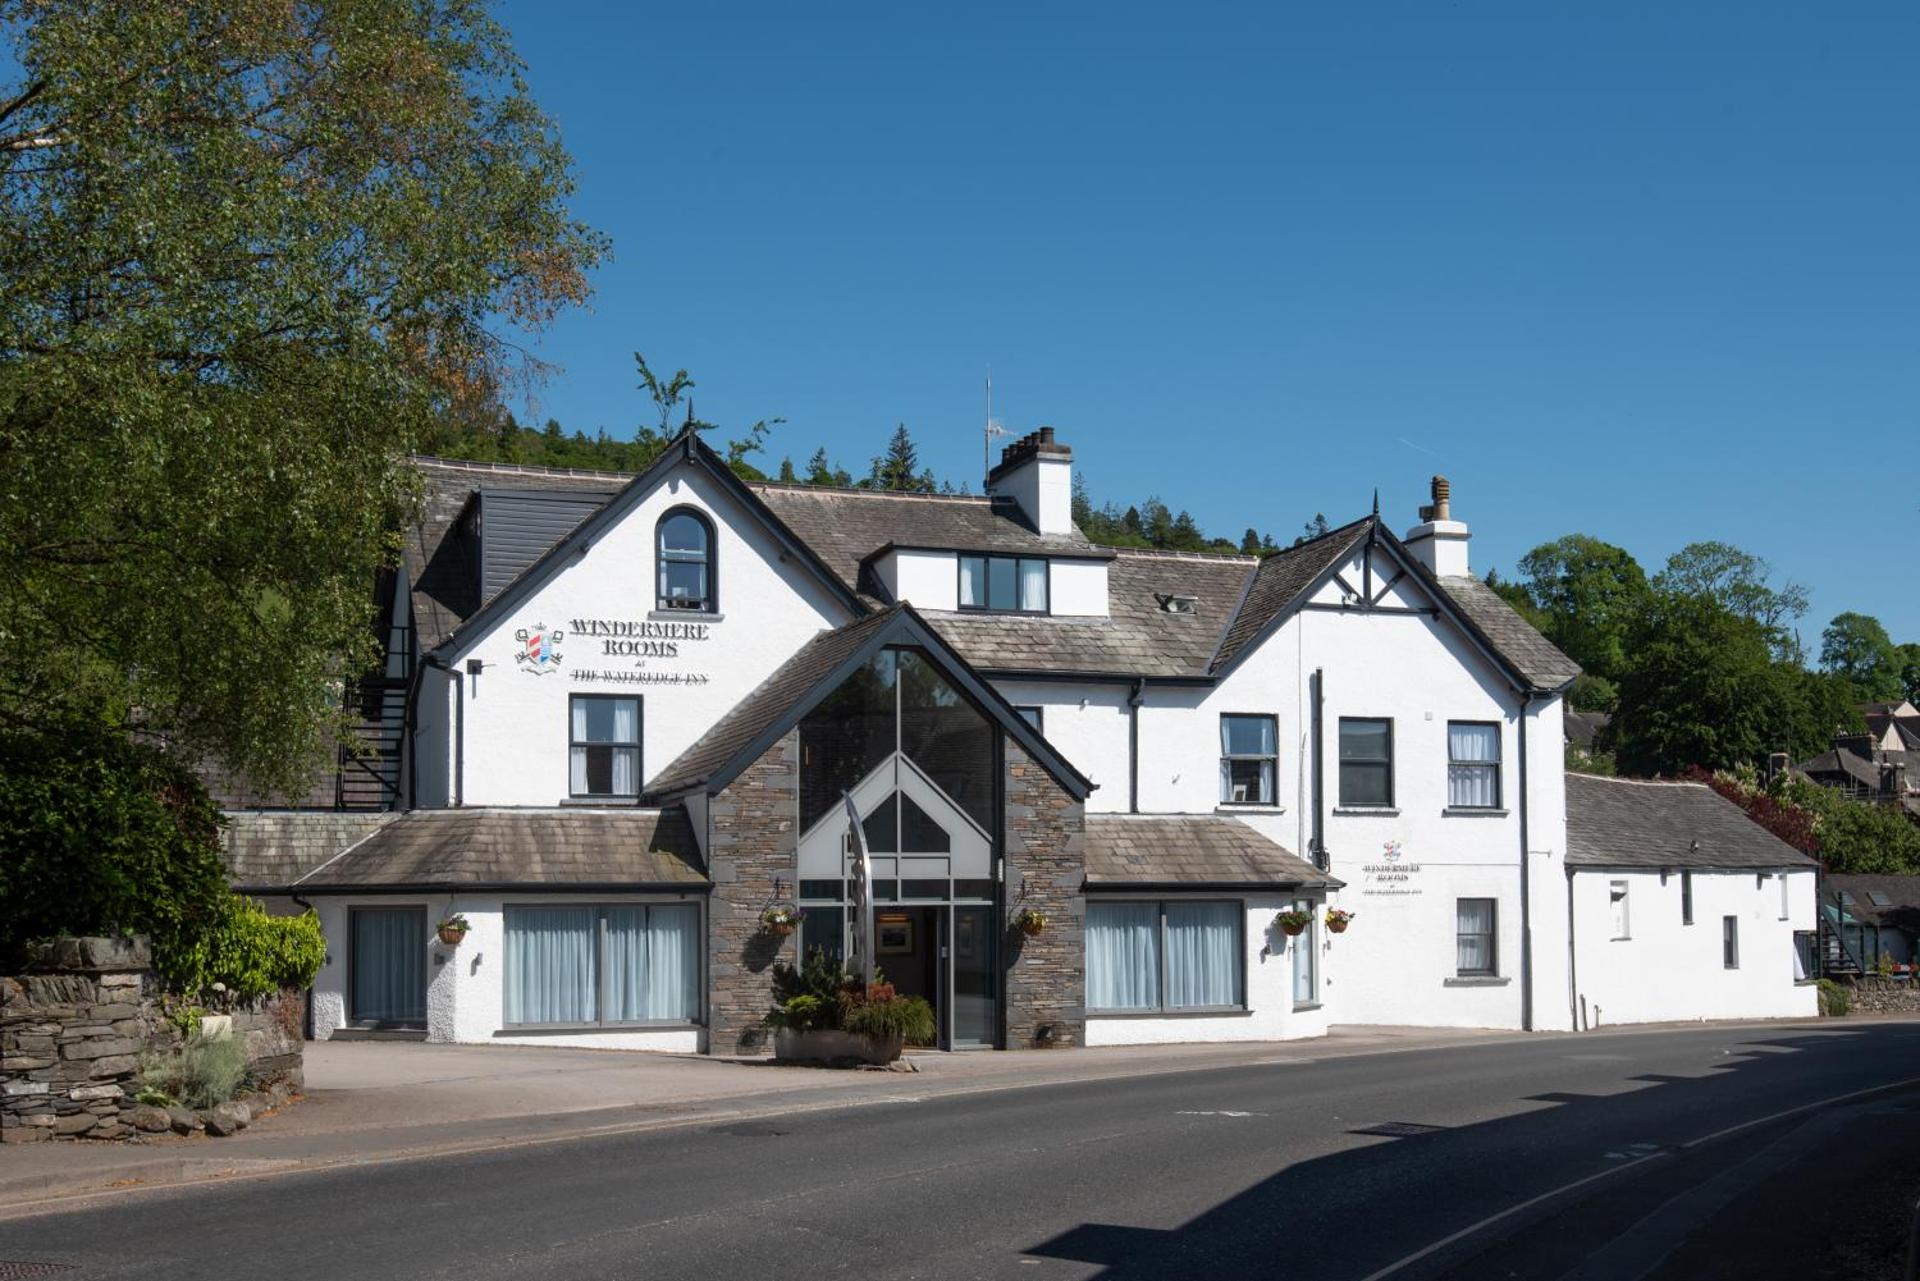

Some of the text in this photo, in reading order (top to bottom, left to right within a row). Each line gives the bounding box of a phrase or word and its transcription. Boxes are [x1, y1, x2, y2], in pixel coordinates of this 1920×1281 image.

[570, 619, 709, 640] WINDERMERE
[602, 640, 678, 656] ROOMS
[571, 669, 597, 682] THE
